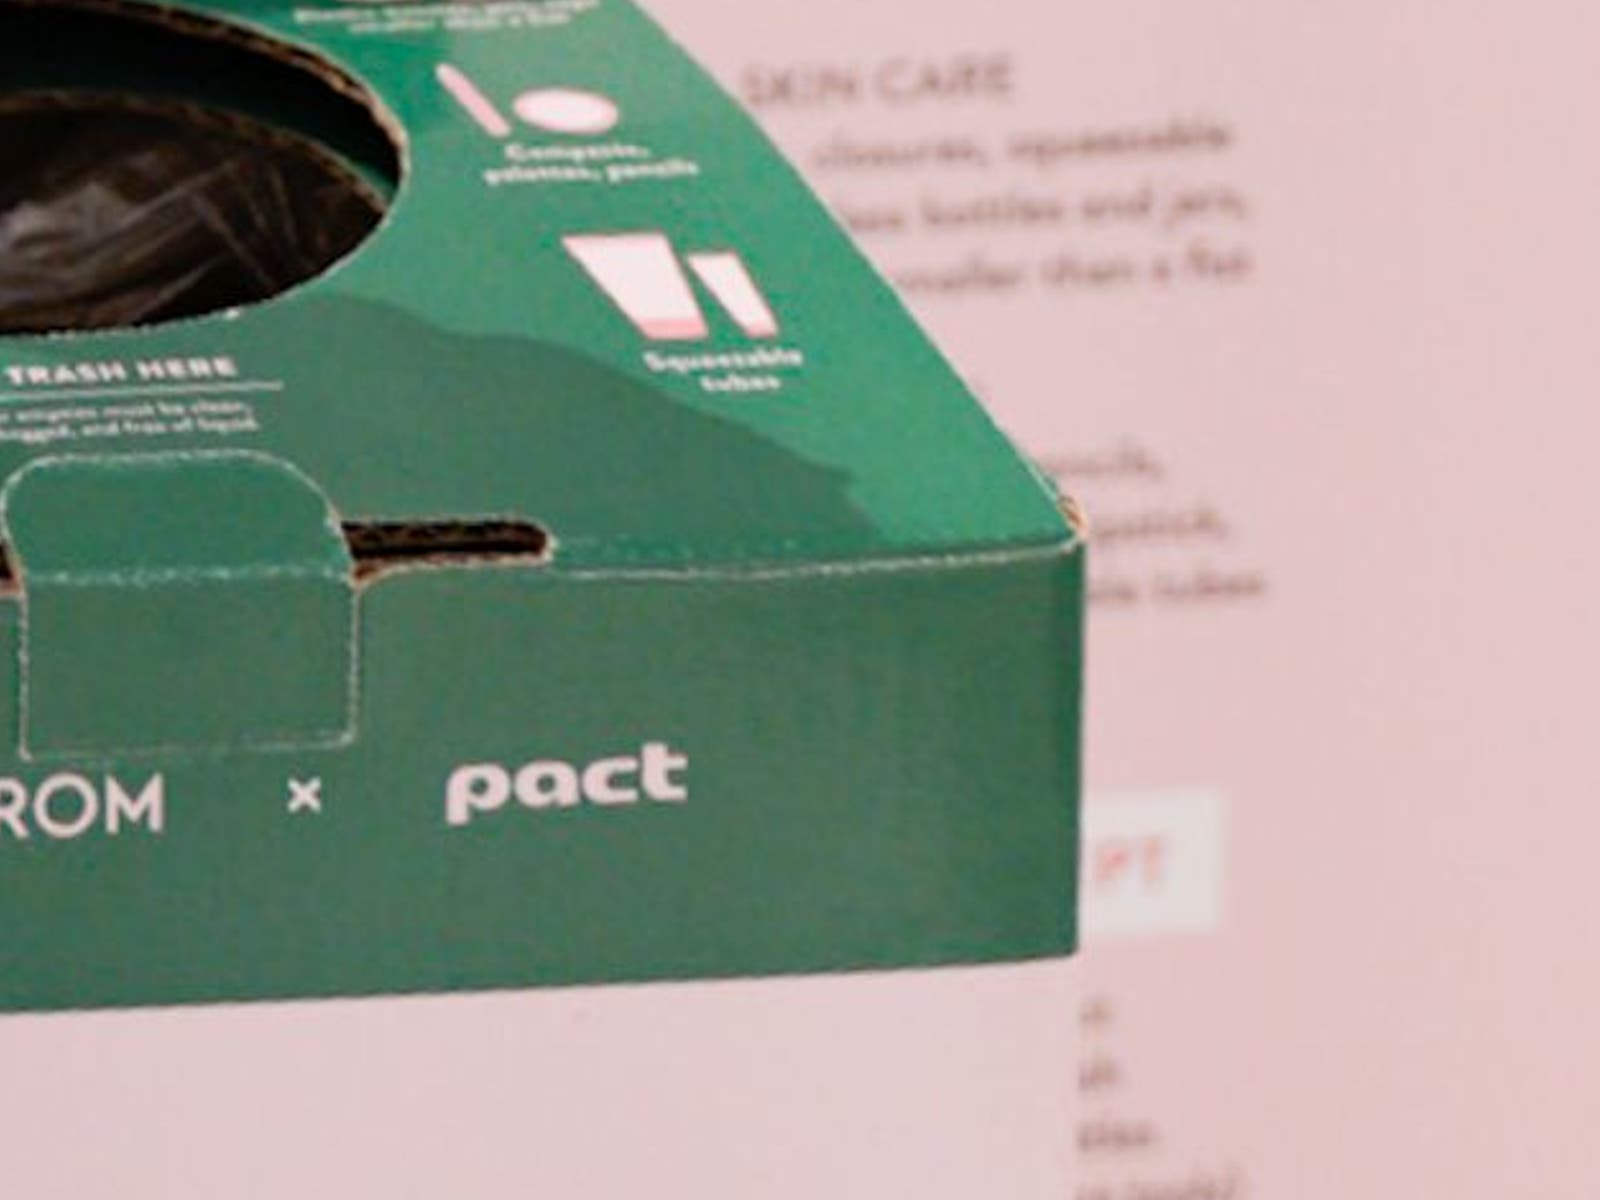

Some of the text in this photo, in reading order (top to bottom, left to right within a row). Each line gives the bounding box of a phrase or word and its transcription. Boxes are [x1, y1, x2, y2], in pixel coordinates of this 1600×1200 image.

[741, 56, 1016, 107] SKIN CARE
[1081, 182, 1153, 220] and
[1039, 250, 1135, 287] than
[5, 360, 128, 386] TRASH
[135, 355, 238, 381] HERE
[643, 347, 804, 375] Squeezable
[701, 373, 782, 393] tubes
[445, 741, 690, 827] pact
